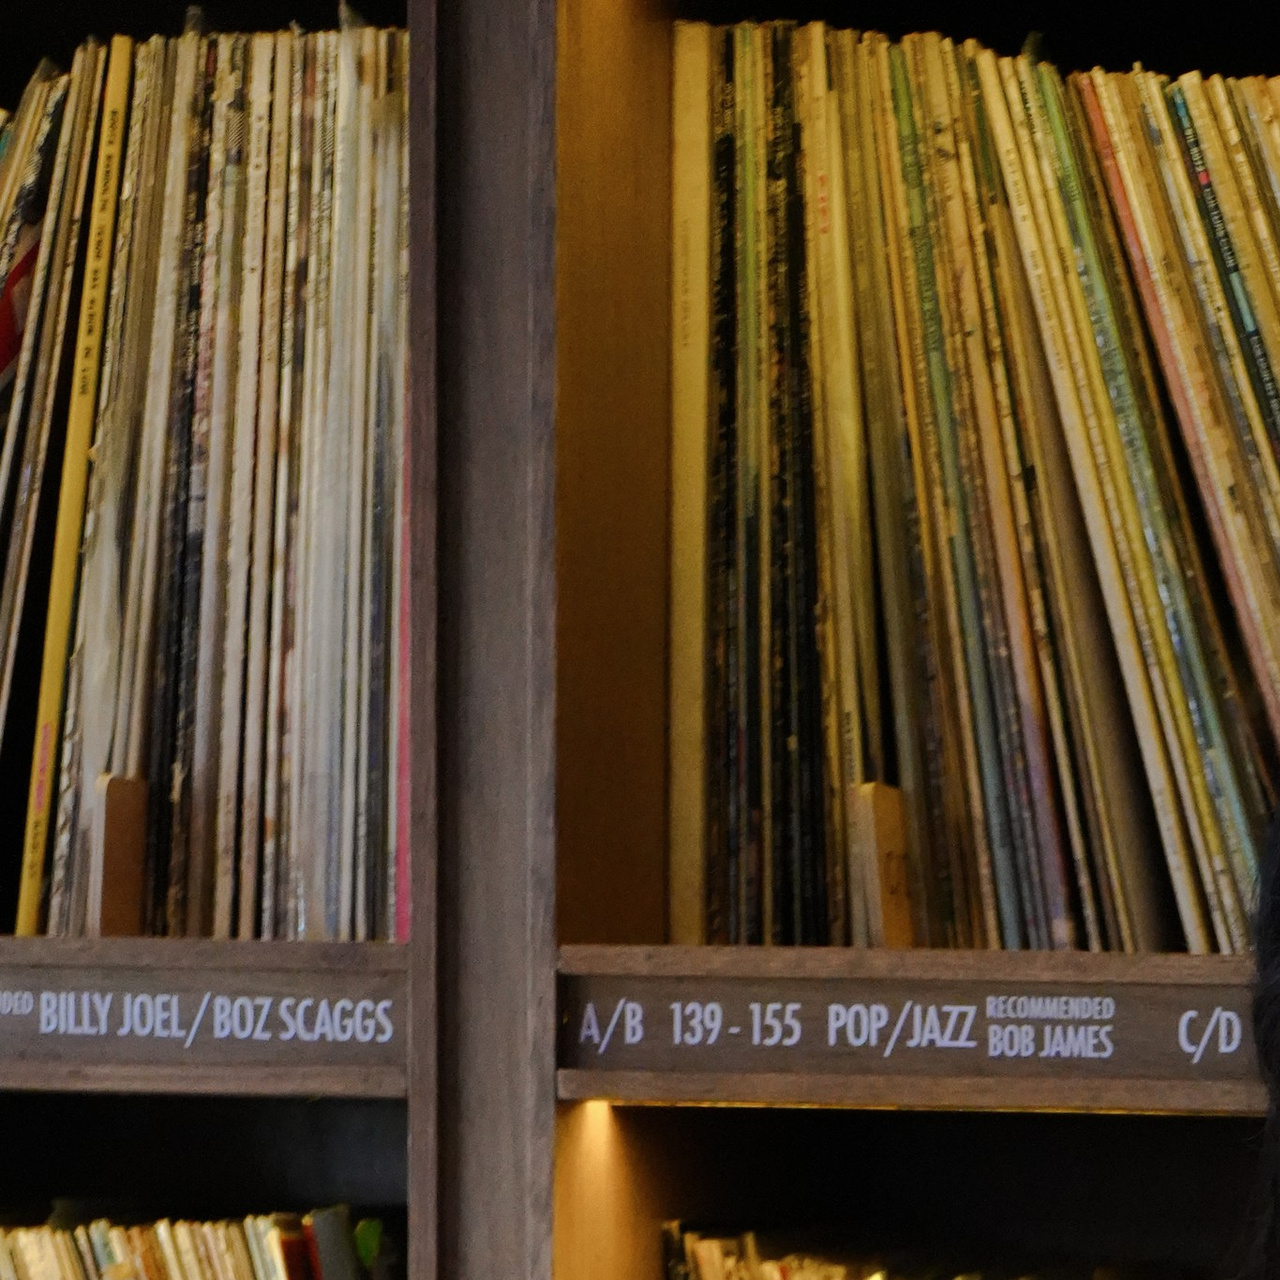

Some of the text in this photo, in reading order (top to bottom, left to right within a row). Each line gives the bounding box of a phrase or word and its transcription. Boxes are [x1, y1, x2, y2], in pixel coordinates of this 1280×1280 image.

[39, 990, 394, 1048] BILLY JOEL/BOZ SCAGGS
[578, 997, 645, 1055] A/B
[827, 998, 977, 1058] POP/JAZZ
[985, 994, 1115, 1021] RECOMMENDED
[1177, 1006, 1242, 1064] C/D
[987, 1024, 1114, 1059] BOB JAMES
